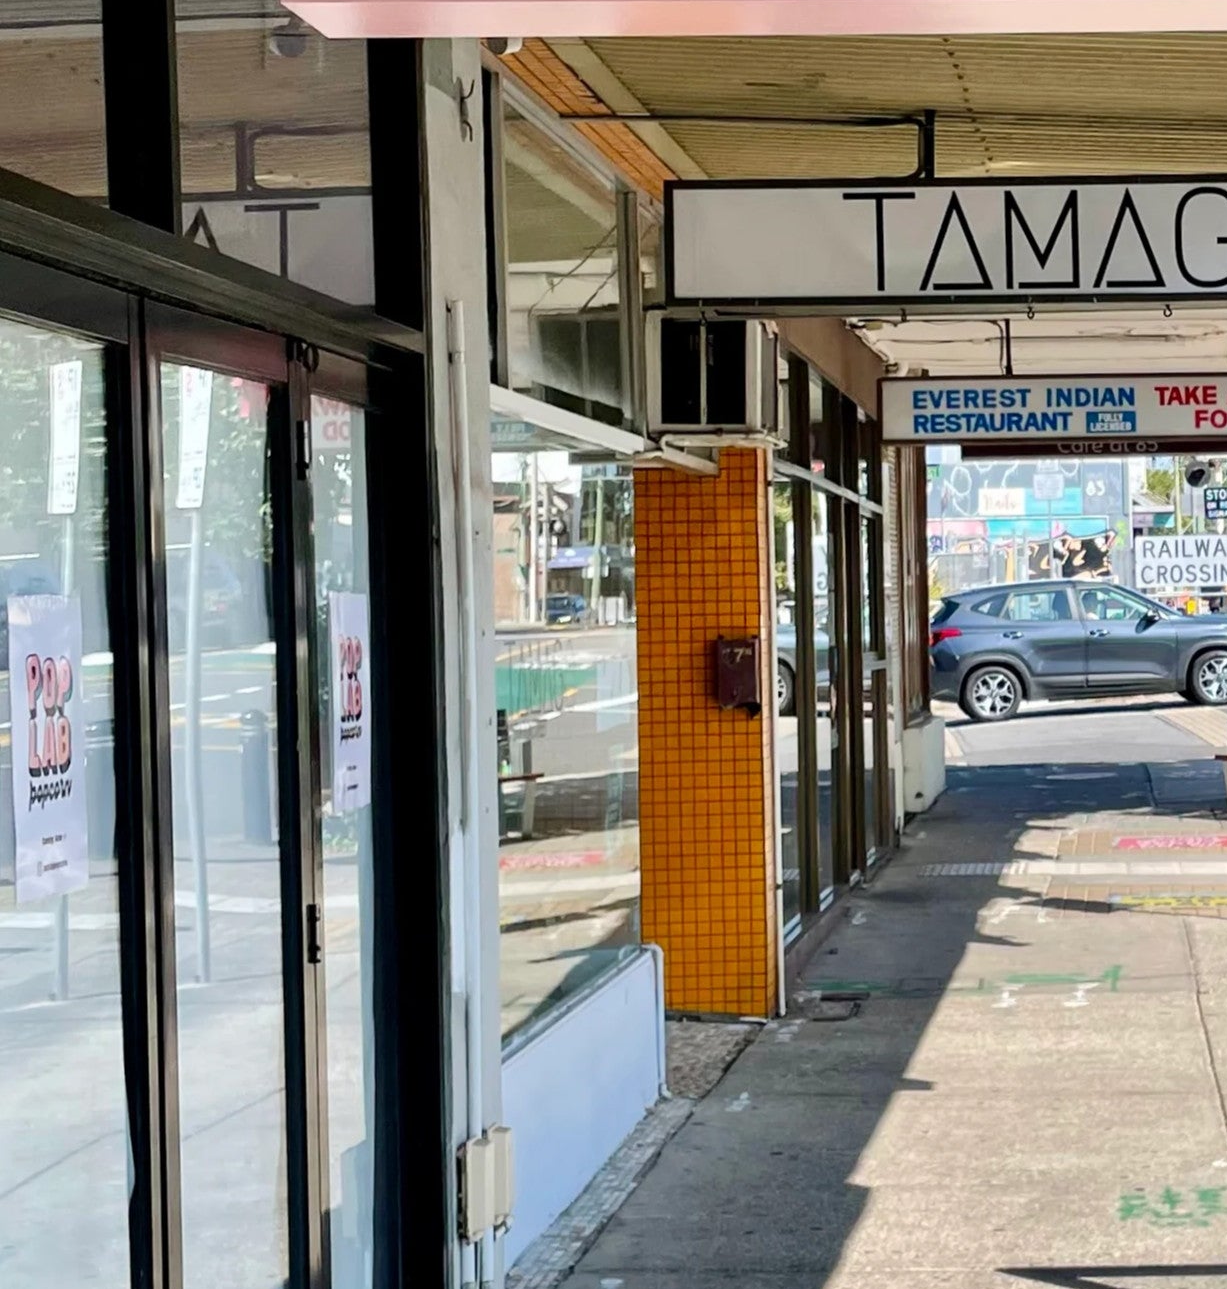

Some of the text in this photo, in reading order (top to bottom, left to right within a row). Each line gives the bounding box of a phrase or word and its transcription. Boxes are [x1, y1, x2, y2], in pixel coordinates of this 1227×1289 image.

[912, 387, 1135, 409] EVEREST INDIAN
[1154, 386, 1217, 406] TAKE
[913, 412, 1073, 434] RESTAURANT
[1098, 413, 1123, 422] FULLY
[25, 653, 73, 719] POP
[28, 715, 72, 778] LAB
